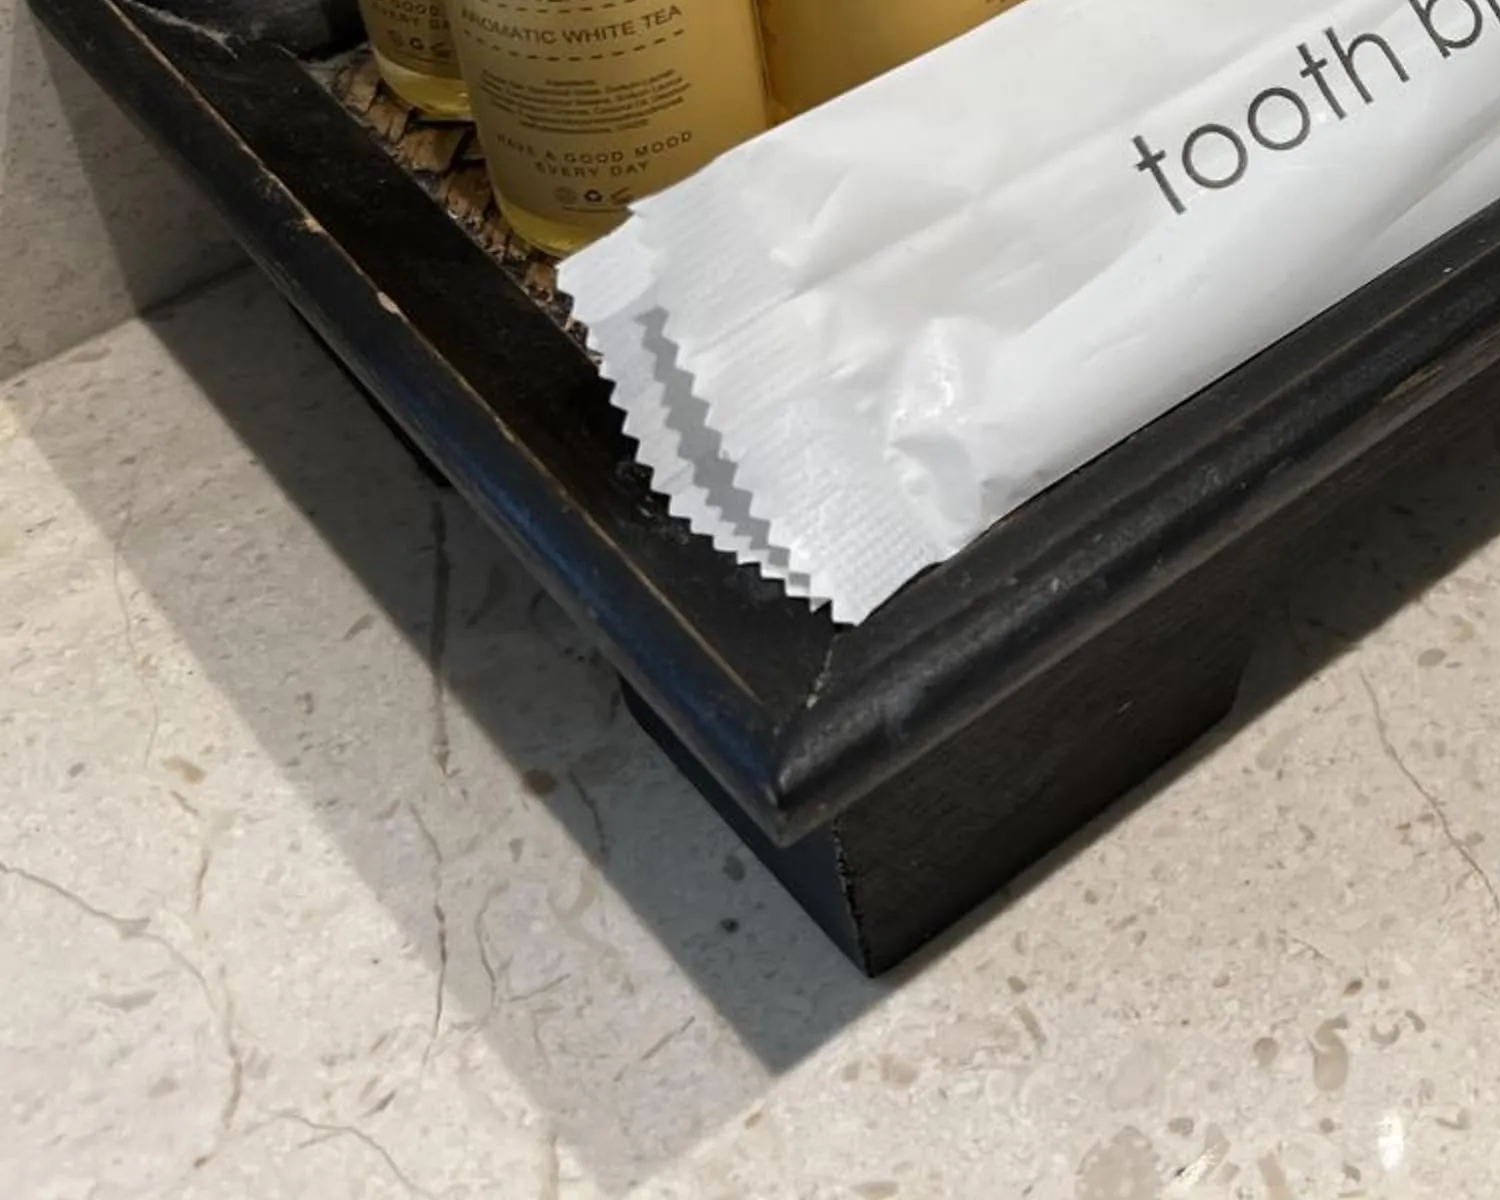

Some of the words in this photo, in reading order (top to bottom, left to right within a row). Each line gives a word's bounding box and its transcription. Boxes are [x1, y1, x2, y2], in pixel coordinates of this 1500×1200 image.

[460, 8, 558, 46] AROMATIC
[561, 20, 638, 45] WHITE
[641, 4, 684, 31] TEA
[1131, 26, 1410, 215] tooth
[563, 151, 625, 165] GOOD
[633, 131, 693, 157] MOOD
[535, 161, 599, 178] EVERY
[610, 161, 650, 178] DAY
